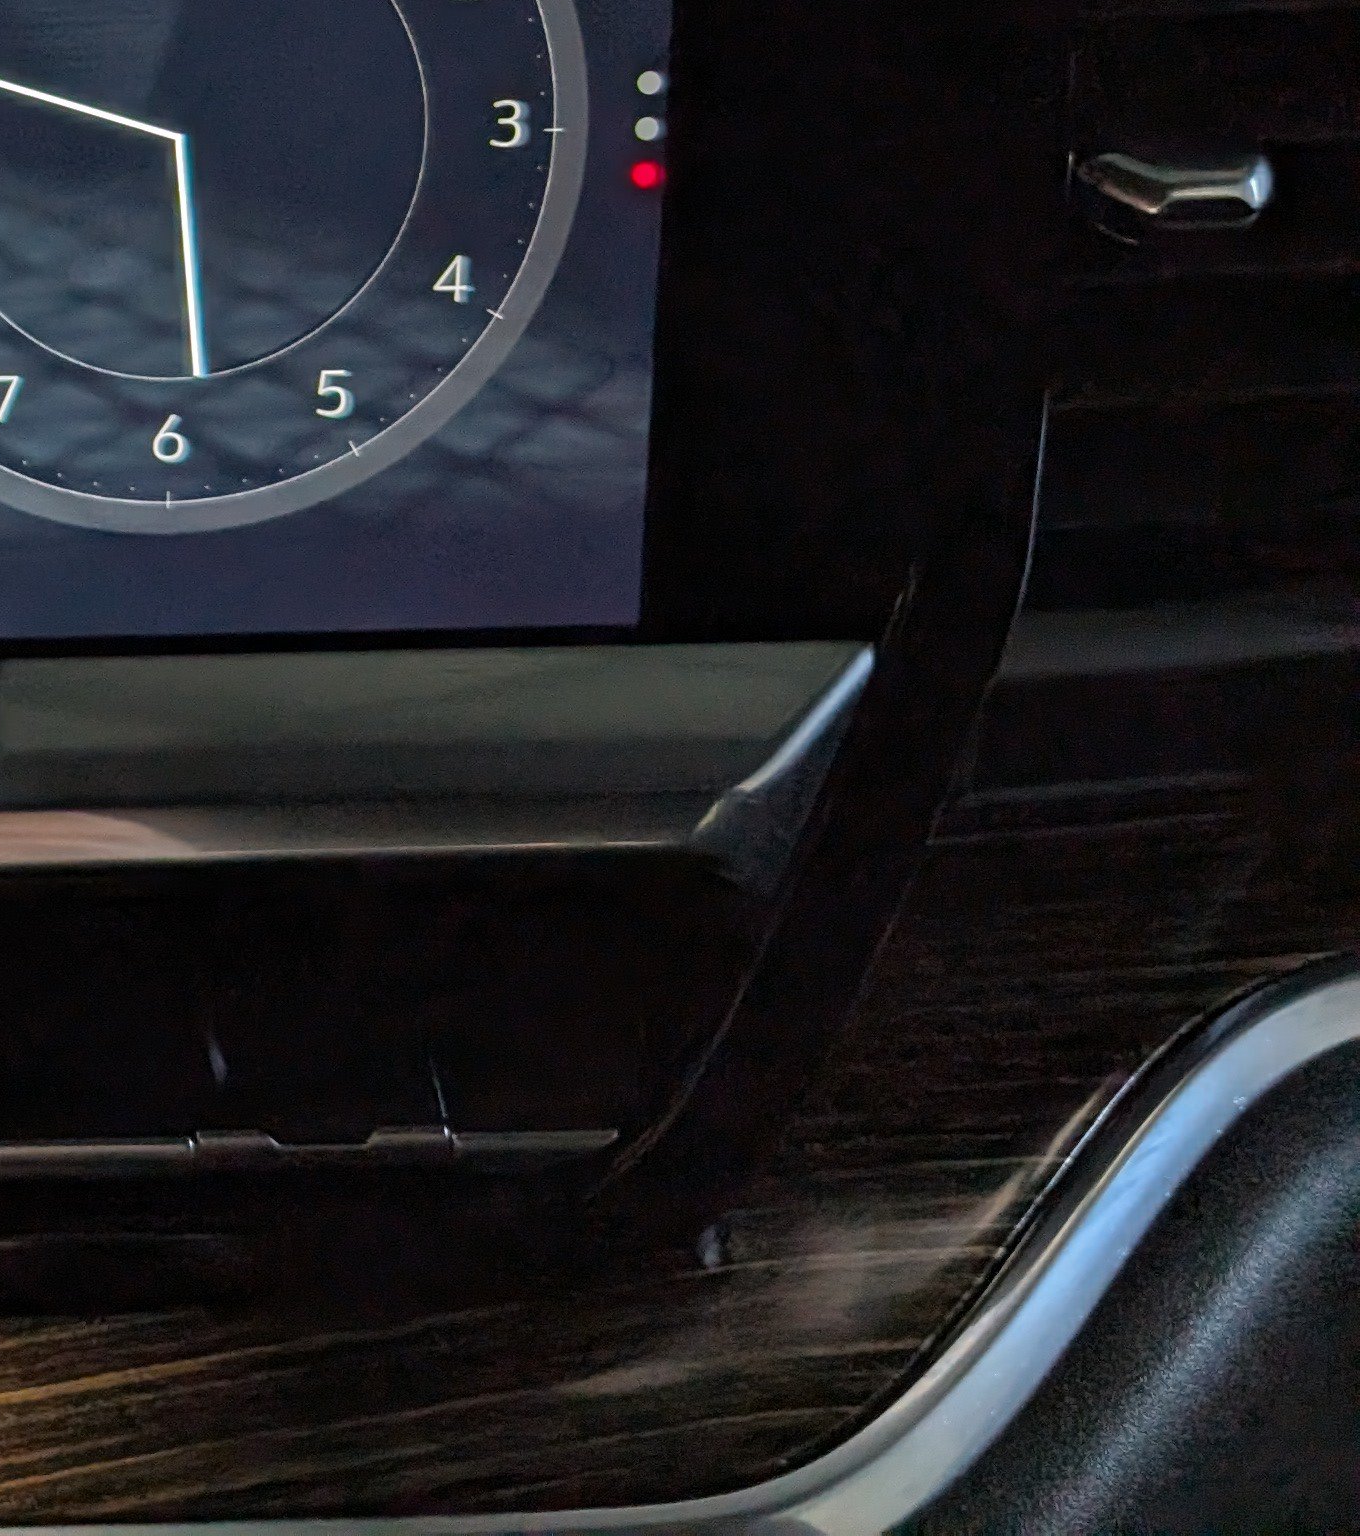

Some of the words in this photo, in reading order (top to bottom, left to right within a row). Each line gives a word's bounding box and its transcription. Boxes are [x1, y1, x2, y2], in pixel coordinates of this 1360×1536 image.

[490, 100, 524, 147] 3
[433, 255, 473, 302] 4
[316, 370, 349, 417] 5
[153, 414, 187, 462] 6
